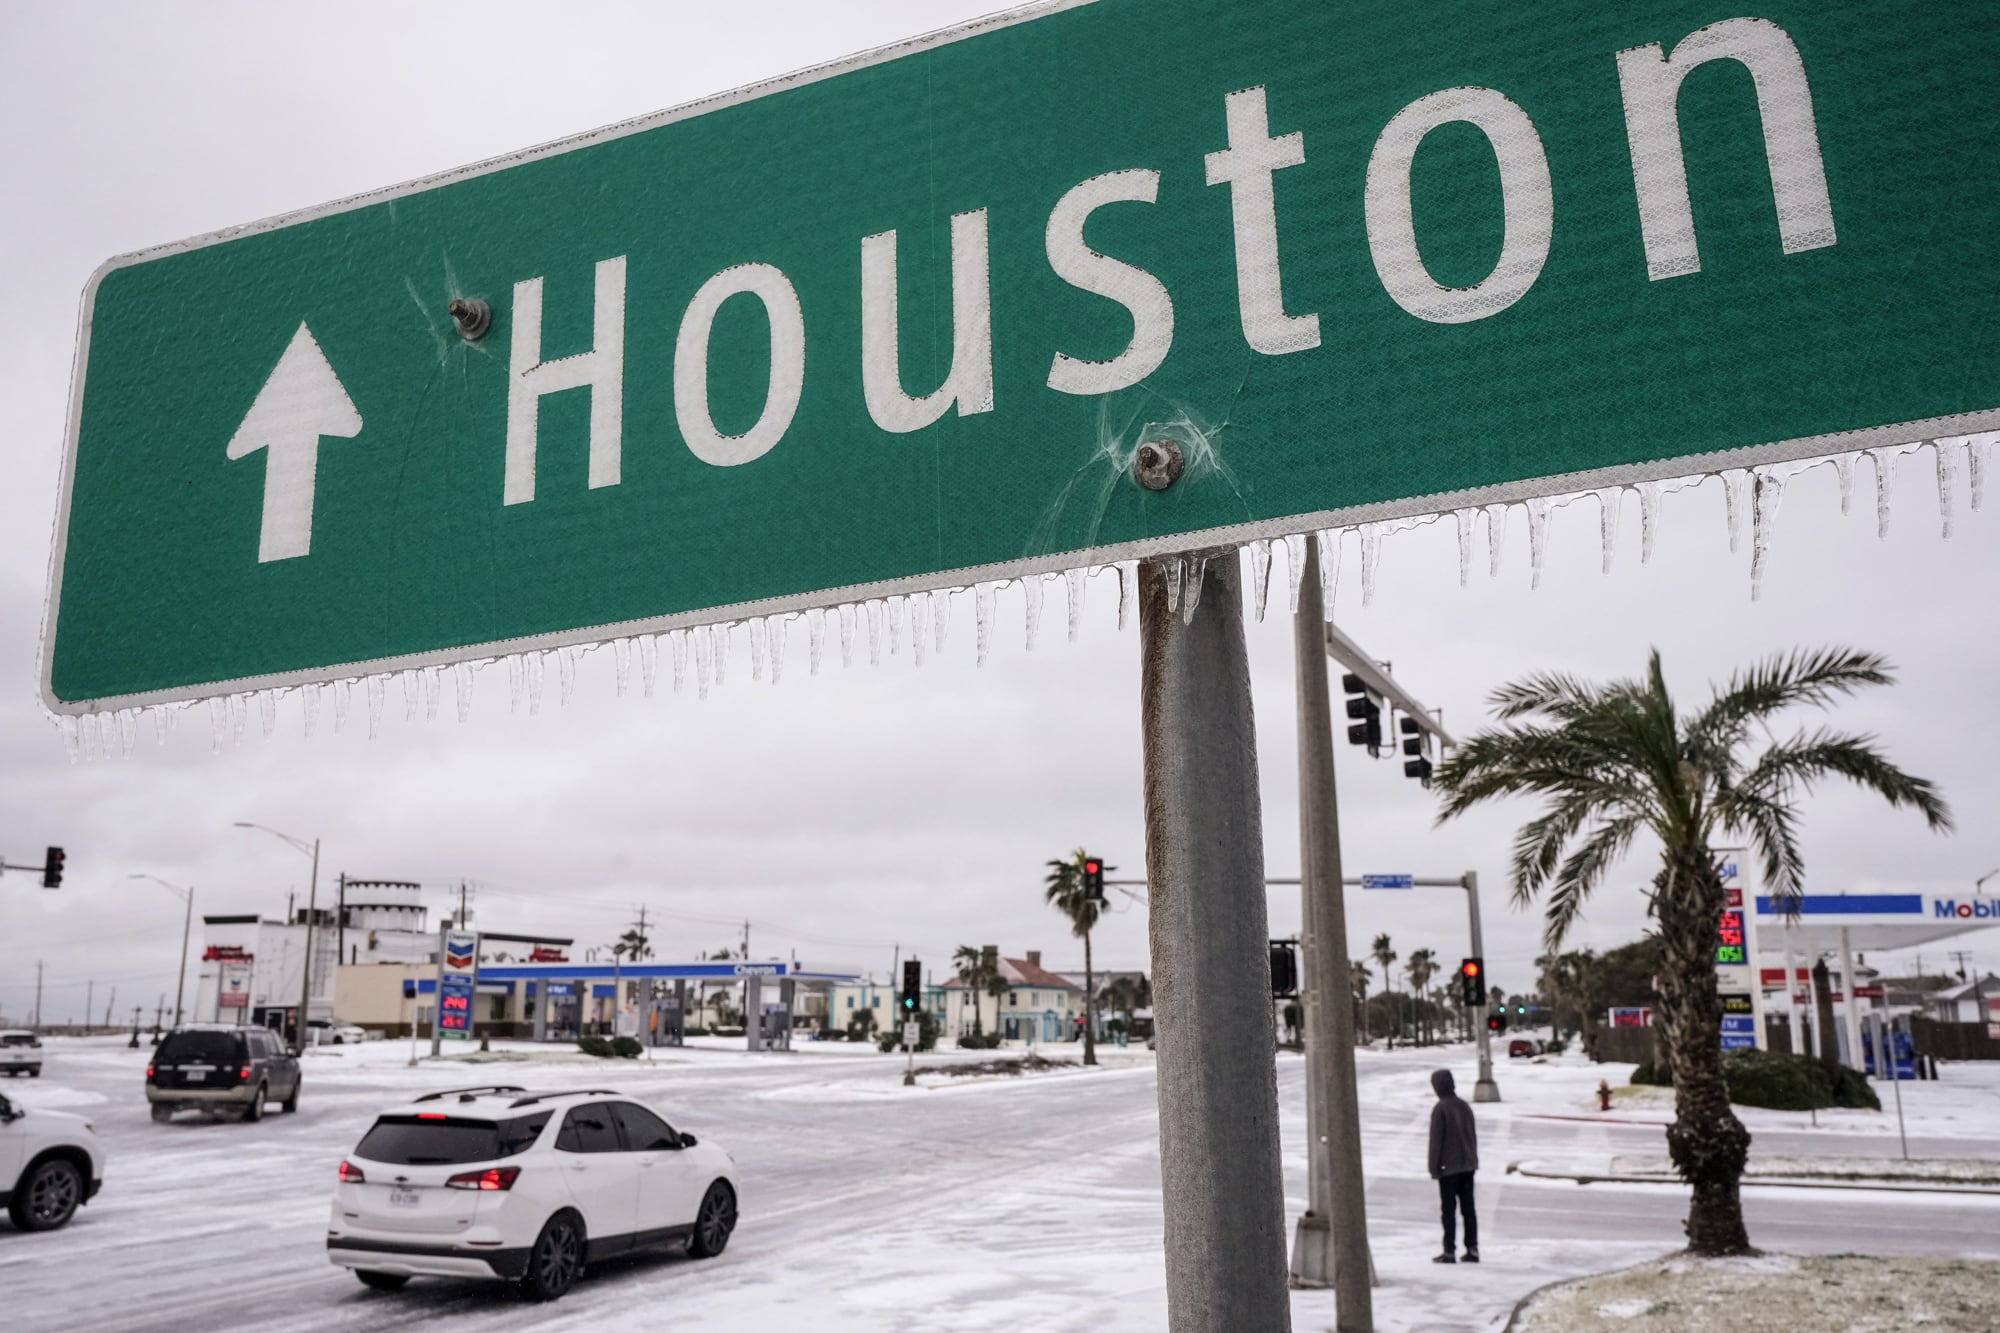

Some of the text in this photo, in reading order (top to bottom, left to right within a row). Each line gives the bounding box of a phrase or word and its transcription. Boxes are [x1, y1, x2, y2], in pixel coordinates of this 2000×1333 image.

[502, 17, 1838, 507] Houston
[1934, 898, 2000, 918] Mobil
[733, 965, 777, 977] Chevron
